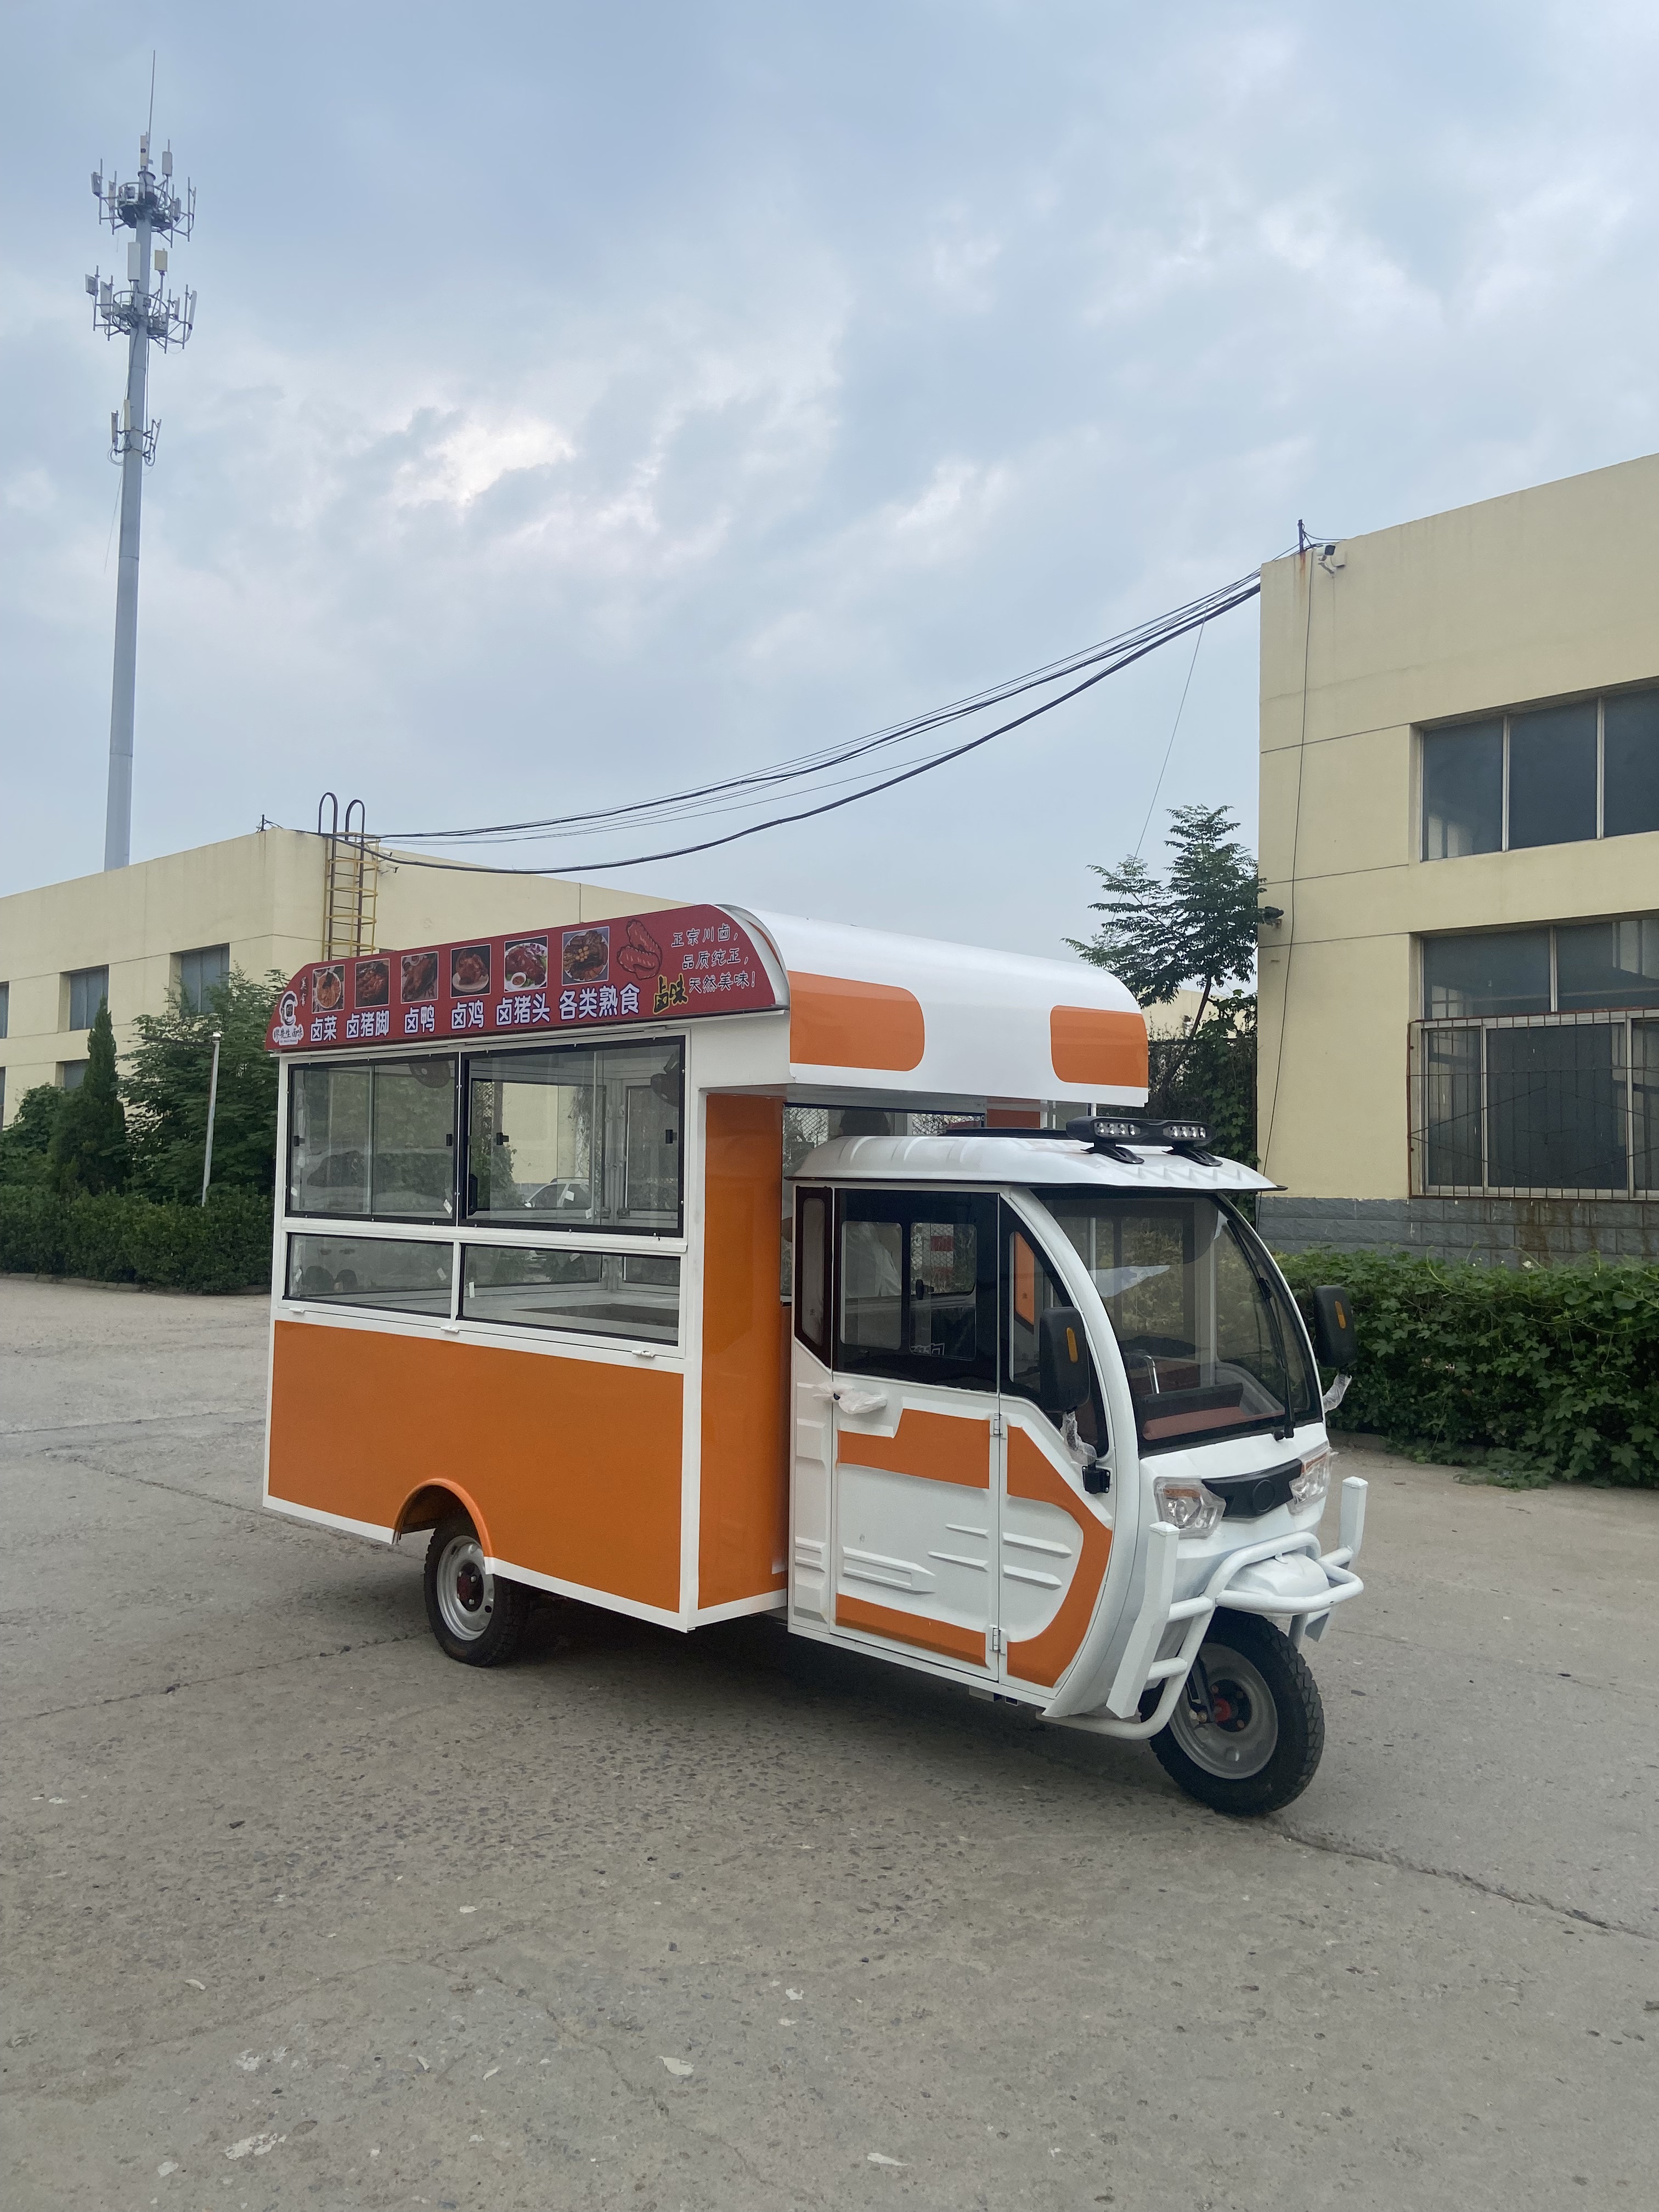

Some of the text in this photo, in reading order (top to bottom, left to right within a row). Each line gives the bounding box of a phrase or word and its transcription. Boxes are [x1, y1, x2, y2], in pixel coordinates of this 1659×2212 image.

[311, 983, 640, 1042] 卤菜 卤猪脚 卤鸭 卤鸡 卤猪头 各类熟食
[653, 973, 689, 1015] 卤味
